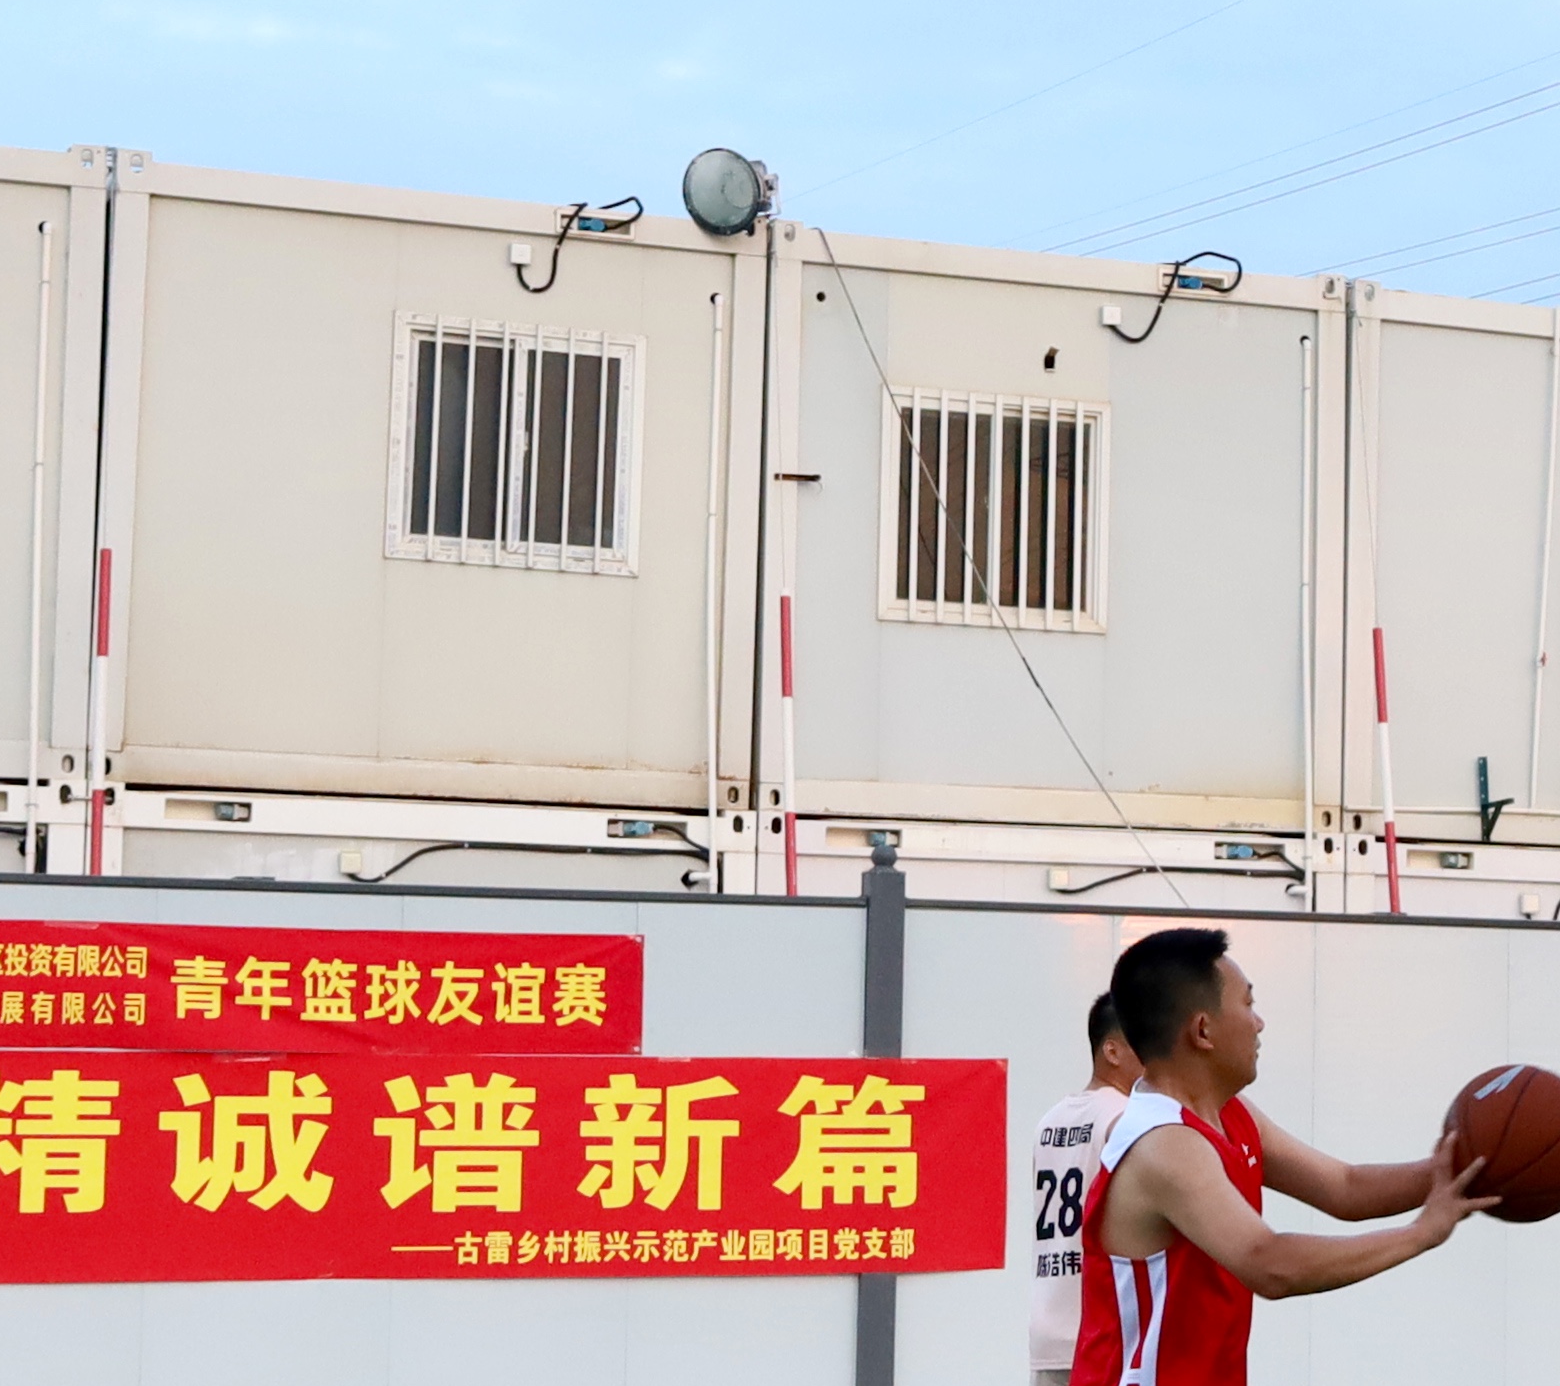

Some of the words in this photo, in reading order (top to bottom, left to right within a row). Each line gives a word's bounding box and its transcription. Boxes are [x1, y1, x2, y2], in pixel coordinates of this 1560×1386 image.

[170, 956, 608, 1027] 青年篮球友谊赛
[1041, 1123, 1093, 1147] 中建四局
[1036, 1167, 1083, 1240] 28
